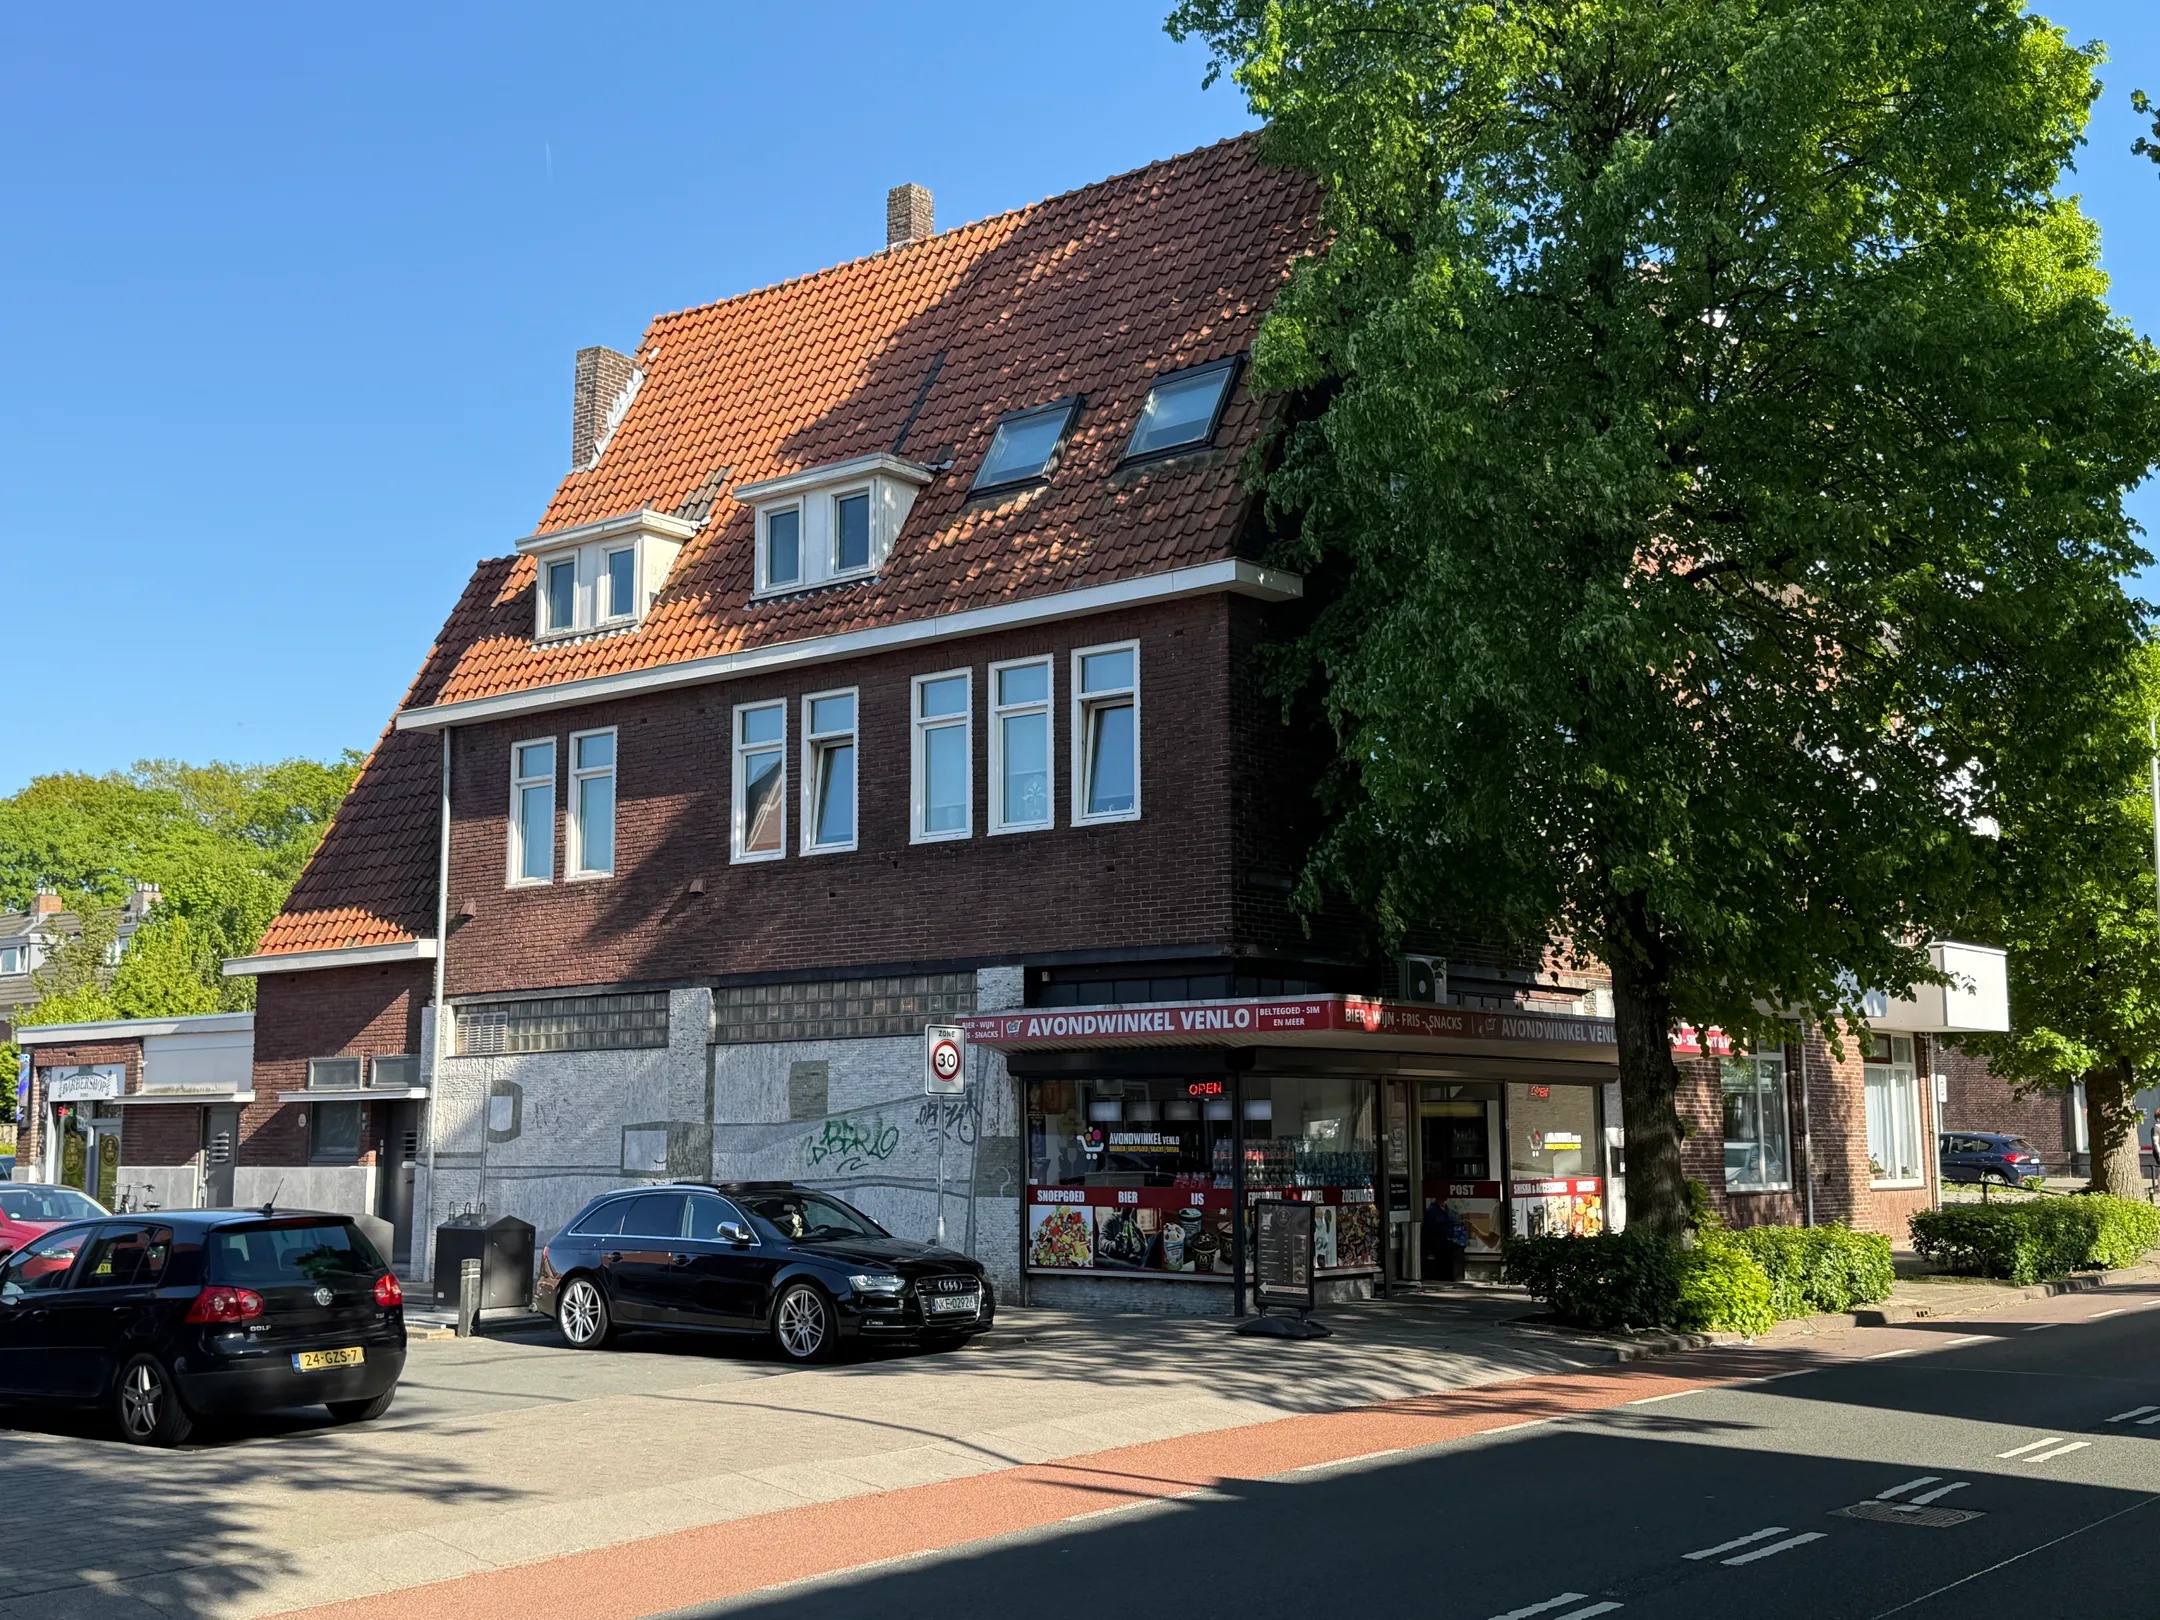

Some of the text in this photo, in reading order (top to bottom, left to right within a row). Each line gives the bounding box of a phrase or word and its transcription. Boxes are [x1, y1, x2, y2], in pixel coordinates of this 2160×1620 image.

[1260, 1007, 1300, 1016] BELTEGOED
[1306, 1006, 1320, 1014] SIM
[980, 1021, 995, 1029] WIJN
[1027, 1008, 1250, 1036] AVONDWINKEL VENLO
[1285, 1018, 1305, 1026] MEER
[1345, 1008, 1366, 1023] BIER
[1372, 1010, 1395, 1028] WIJN
[1402, 1013, 1420, 1027] FRIS
[1429, 1015, 1462, 1030] SNACKS
[938, 1030, 956, 1038] ZONE
[974, 1031, 999, 1039] SNACKS
[1501, 1018, 1618, 1043] AVONDWINKEL VENL
[937, 1053, 956, 1068] 30
[63, 1076, 107, 1095] BARBERSHOP
[1189, 1081, 1222, 1096] OPEN
[1109, 1132, 1180, 1145] AVONDWINKEL VENLO
[1037, 1189, 1086, 1203] SNOEPGOED
[1450, 1184, 1475, 1196] POST
[1118, 1191, 1139, 1204] BIER
[304, 1349, 357, 1367] 24-GZS-7
